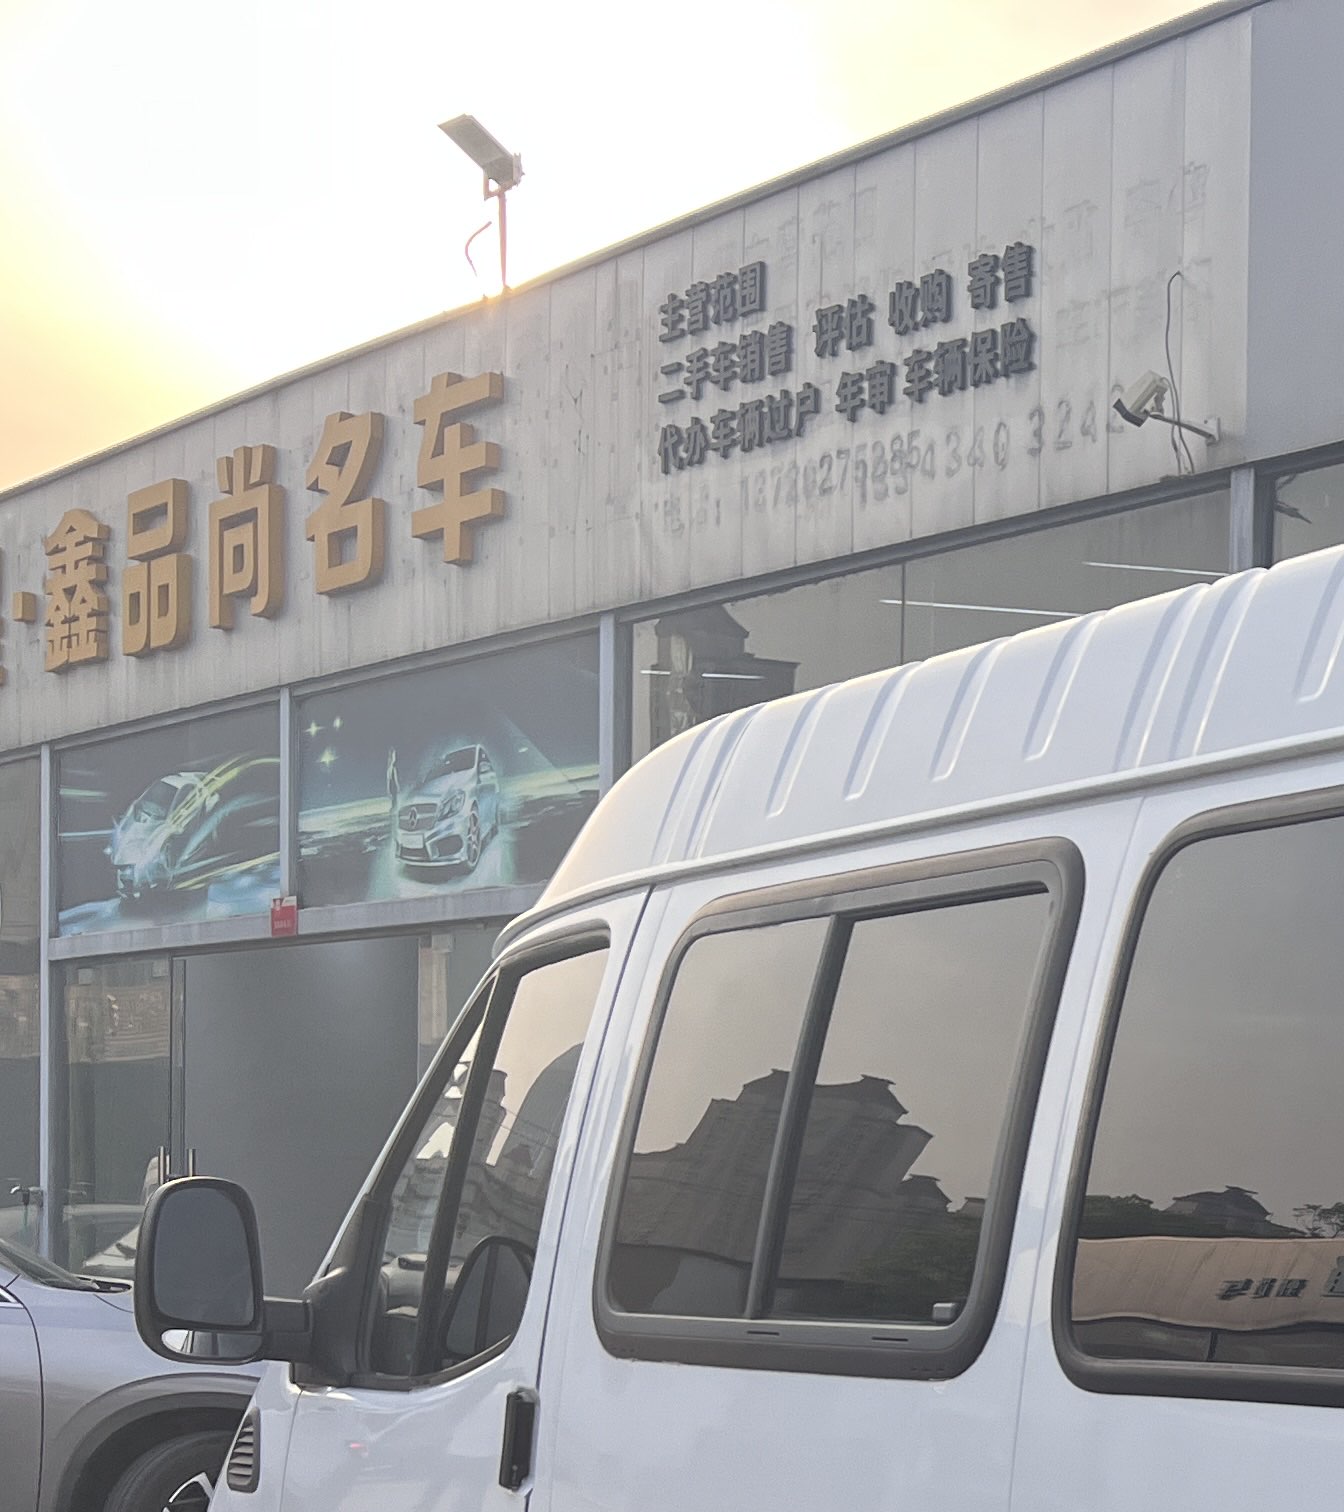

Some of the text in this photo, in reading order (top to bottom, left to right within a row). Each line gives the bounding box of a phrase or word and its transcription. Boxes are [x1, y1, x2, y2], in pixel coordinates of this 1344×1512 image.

[658, 260, 767, 344] 主营范围
[658, 241, 1034, 403] 二手车销售 评估 收购 寄售
[657, 382, 821, 474] 代办车辆过户
[835, 360, 897, 422] 年审
[903, 317, 1036, 401] 车辆保险
